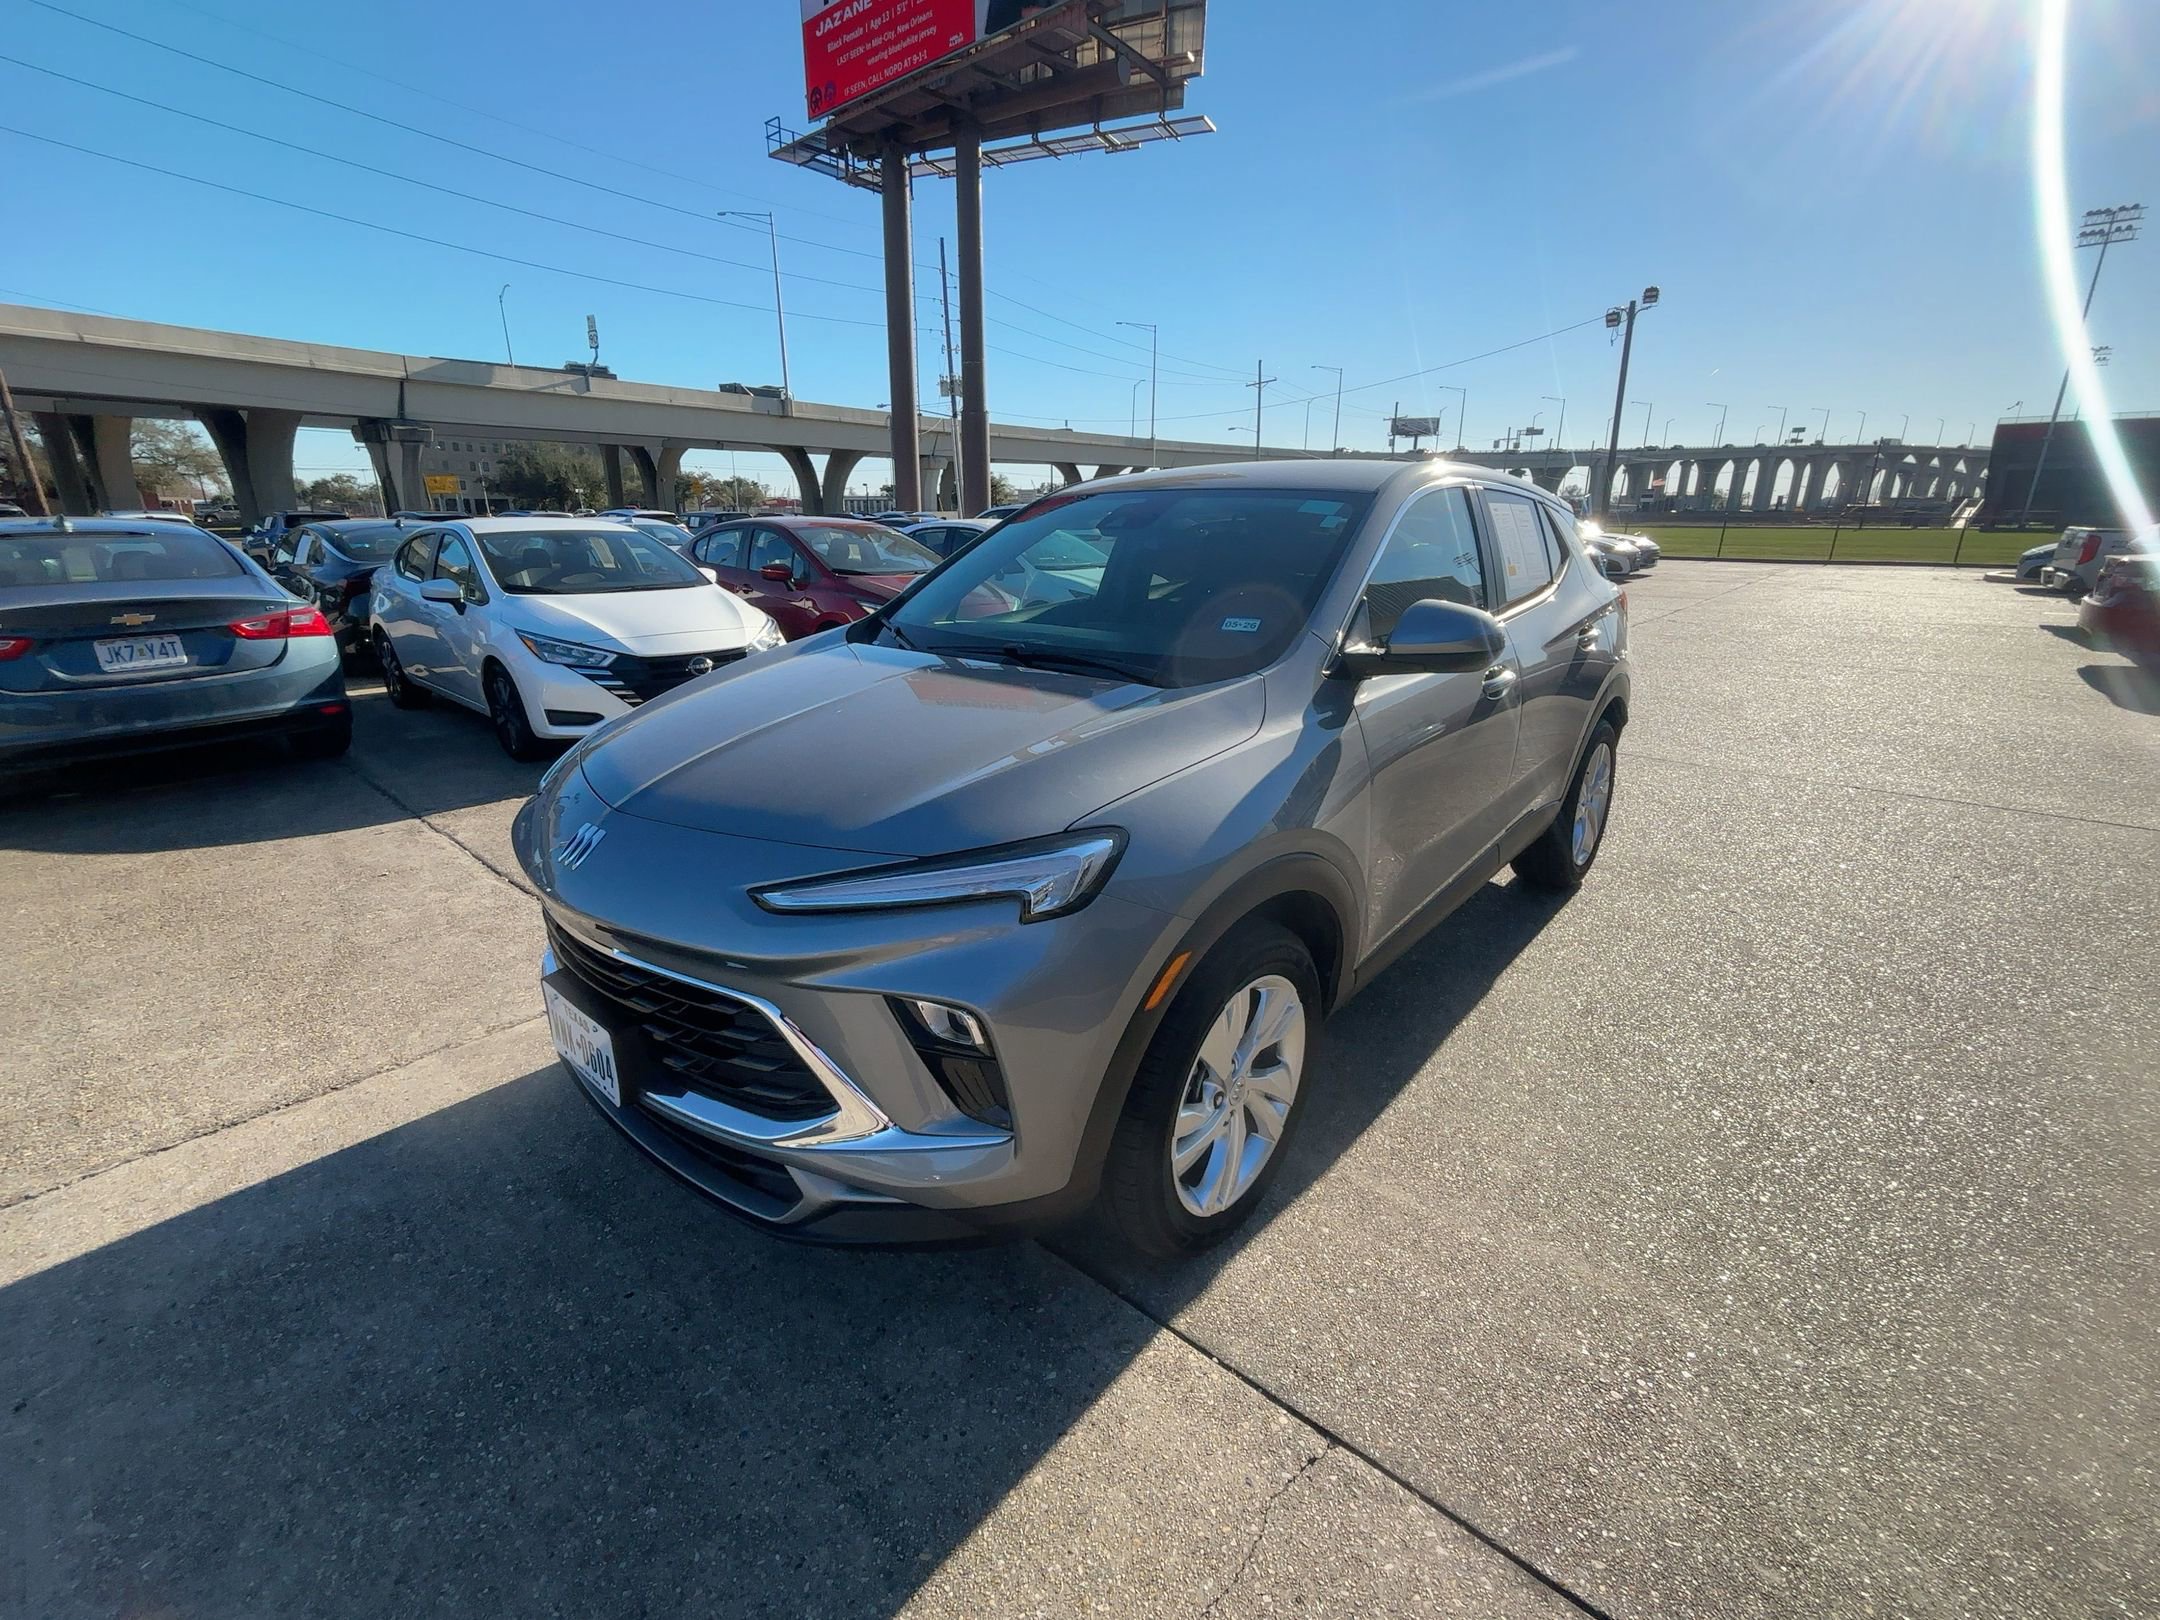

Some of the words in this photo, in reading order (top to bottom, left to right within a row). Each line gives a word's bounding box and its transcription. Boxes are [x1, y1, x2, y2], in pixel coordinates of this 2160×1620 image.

[836, 52, 849, 66] LAST
[897, 22, 910, 35] New
[910, 10, 933, 28] Orleans
[843, 27, 864, 45] Female
[870, 18, 881, 30] Age
[882, 10, 890, 23] 13
[918, 25, 937, 42] jersey
[867, 71, 884, 86] CALL
[884, 61, 903, 79] NOPD
[903, 56, 912, 69] AT
[912, 49, 928, 65] 9-1-1
[105, 642, 136, 664] JK7
[144, 641, 178, 660] Y4T
